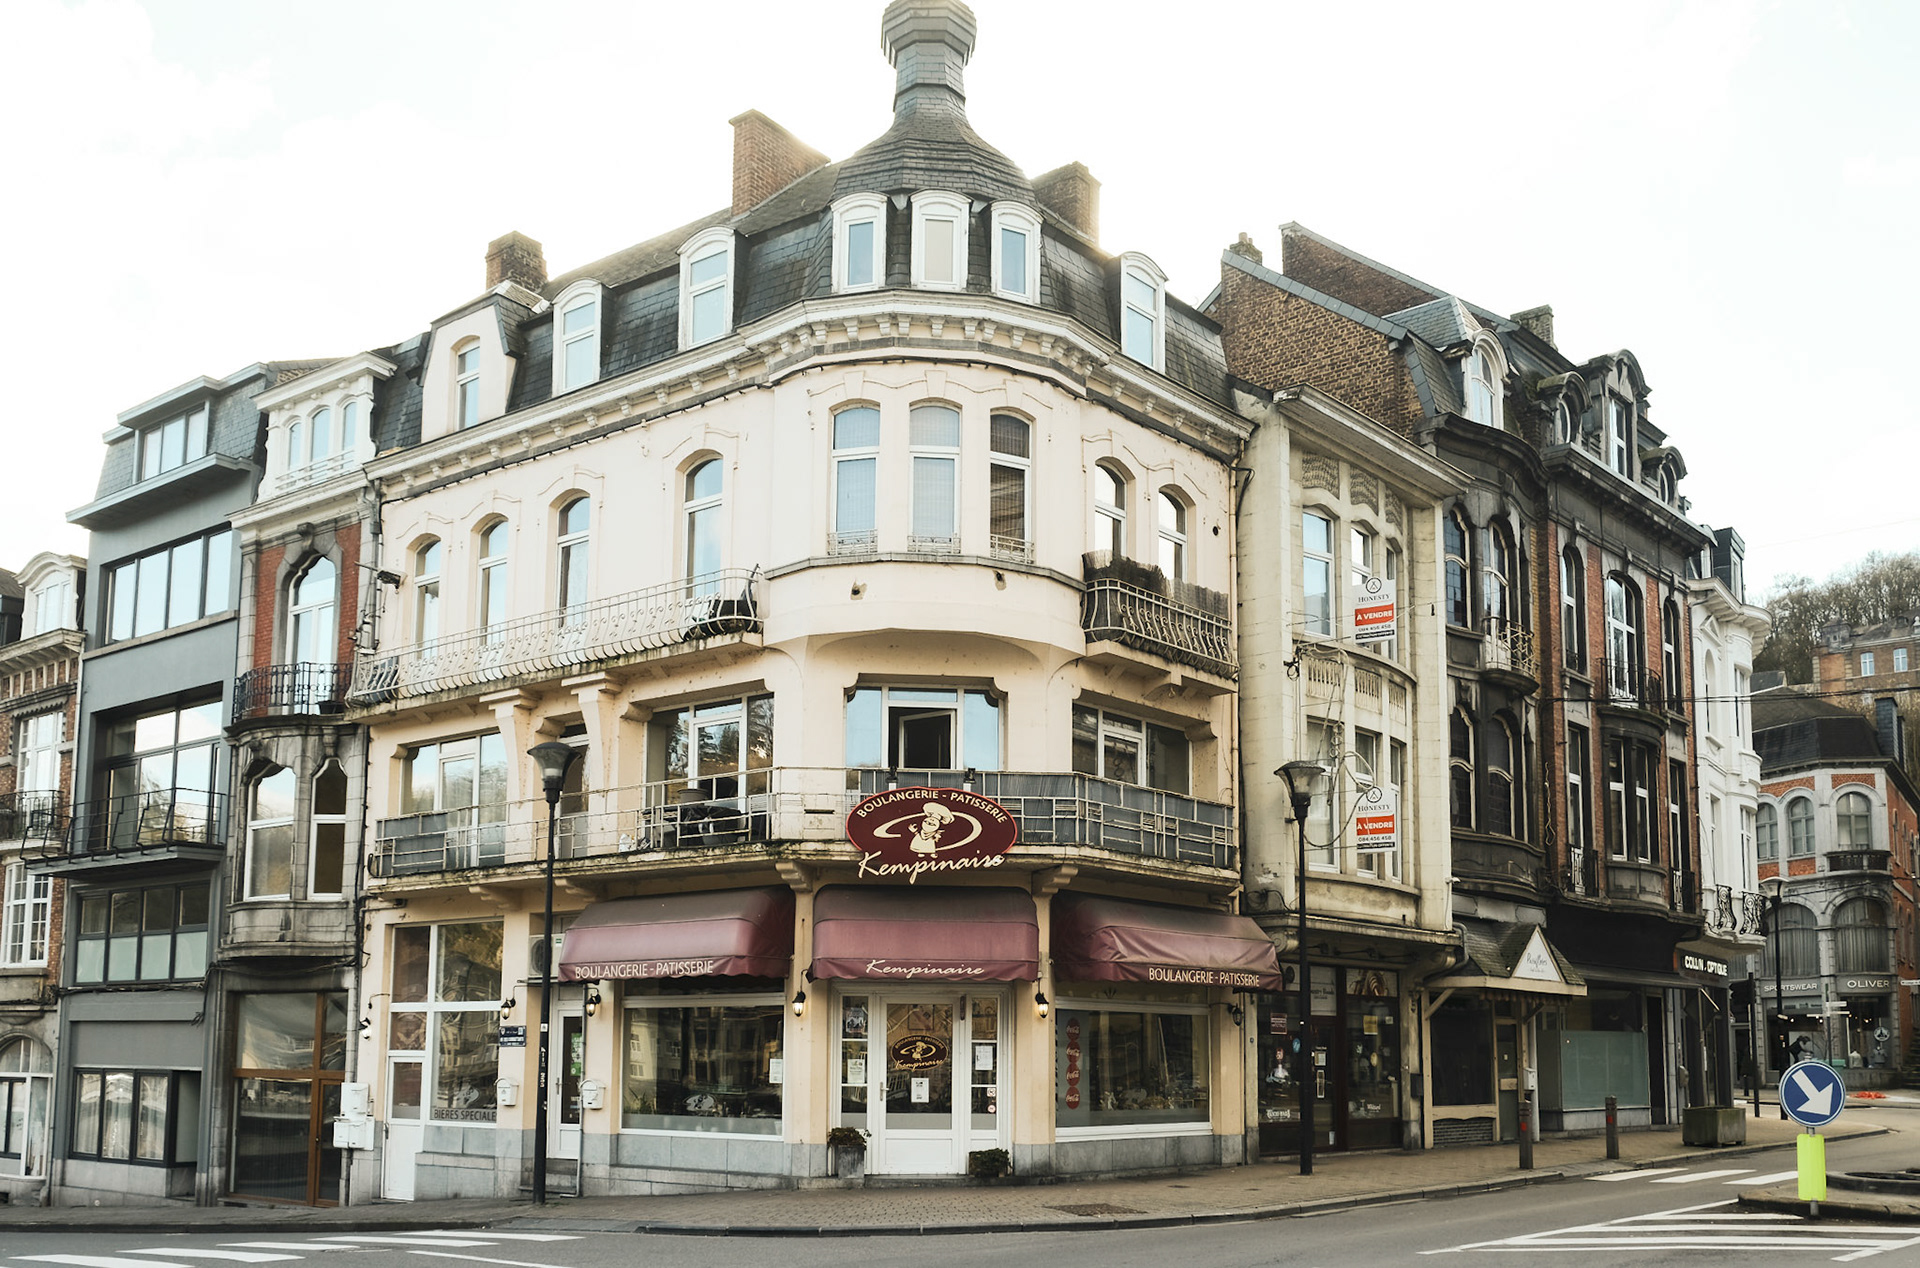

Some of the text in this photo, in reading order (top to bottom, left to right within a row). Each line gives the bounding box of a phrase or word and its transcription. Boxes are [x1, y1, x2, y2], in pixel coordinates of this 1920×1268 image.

[1358, 594, 1390, 603] HONESTY
[1363, 610, 1392, 619] VENDRE
[856, 790, 1009, 823] BOULANGERIE PATISSERIE
[1358, 804, 1390, 812] HONESTY
[857, 849, 1006, 885] Kempinaire
[575, 960, 713, 979] BOULANGERIE PATISSERIE
[866, 959, 985, 979] Kempinaire
[1684, 955, 1728, 976] COLLIN OPTIQUE
[1149, 968, 1260, 987] BOULANGERIE PATISSERIE
[1847, 980, 1890, 988] OLIVER
[434, 1109, 459, 1120] BIERES
